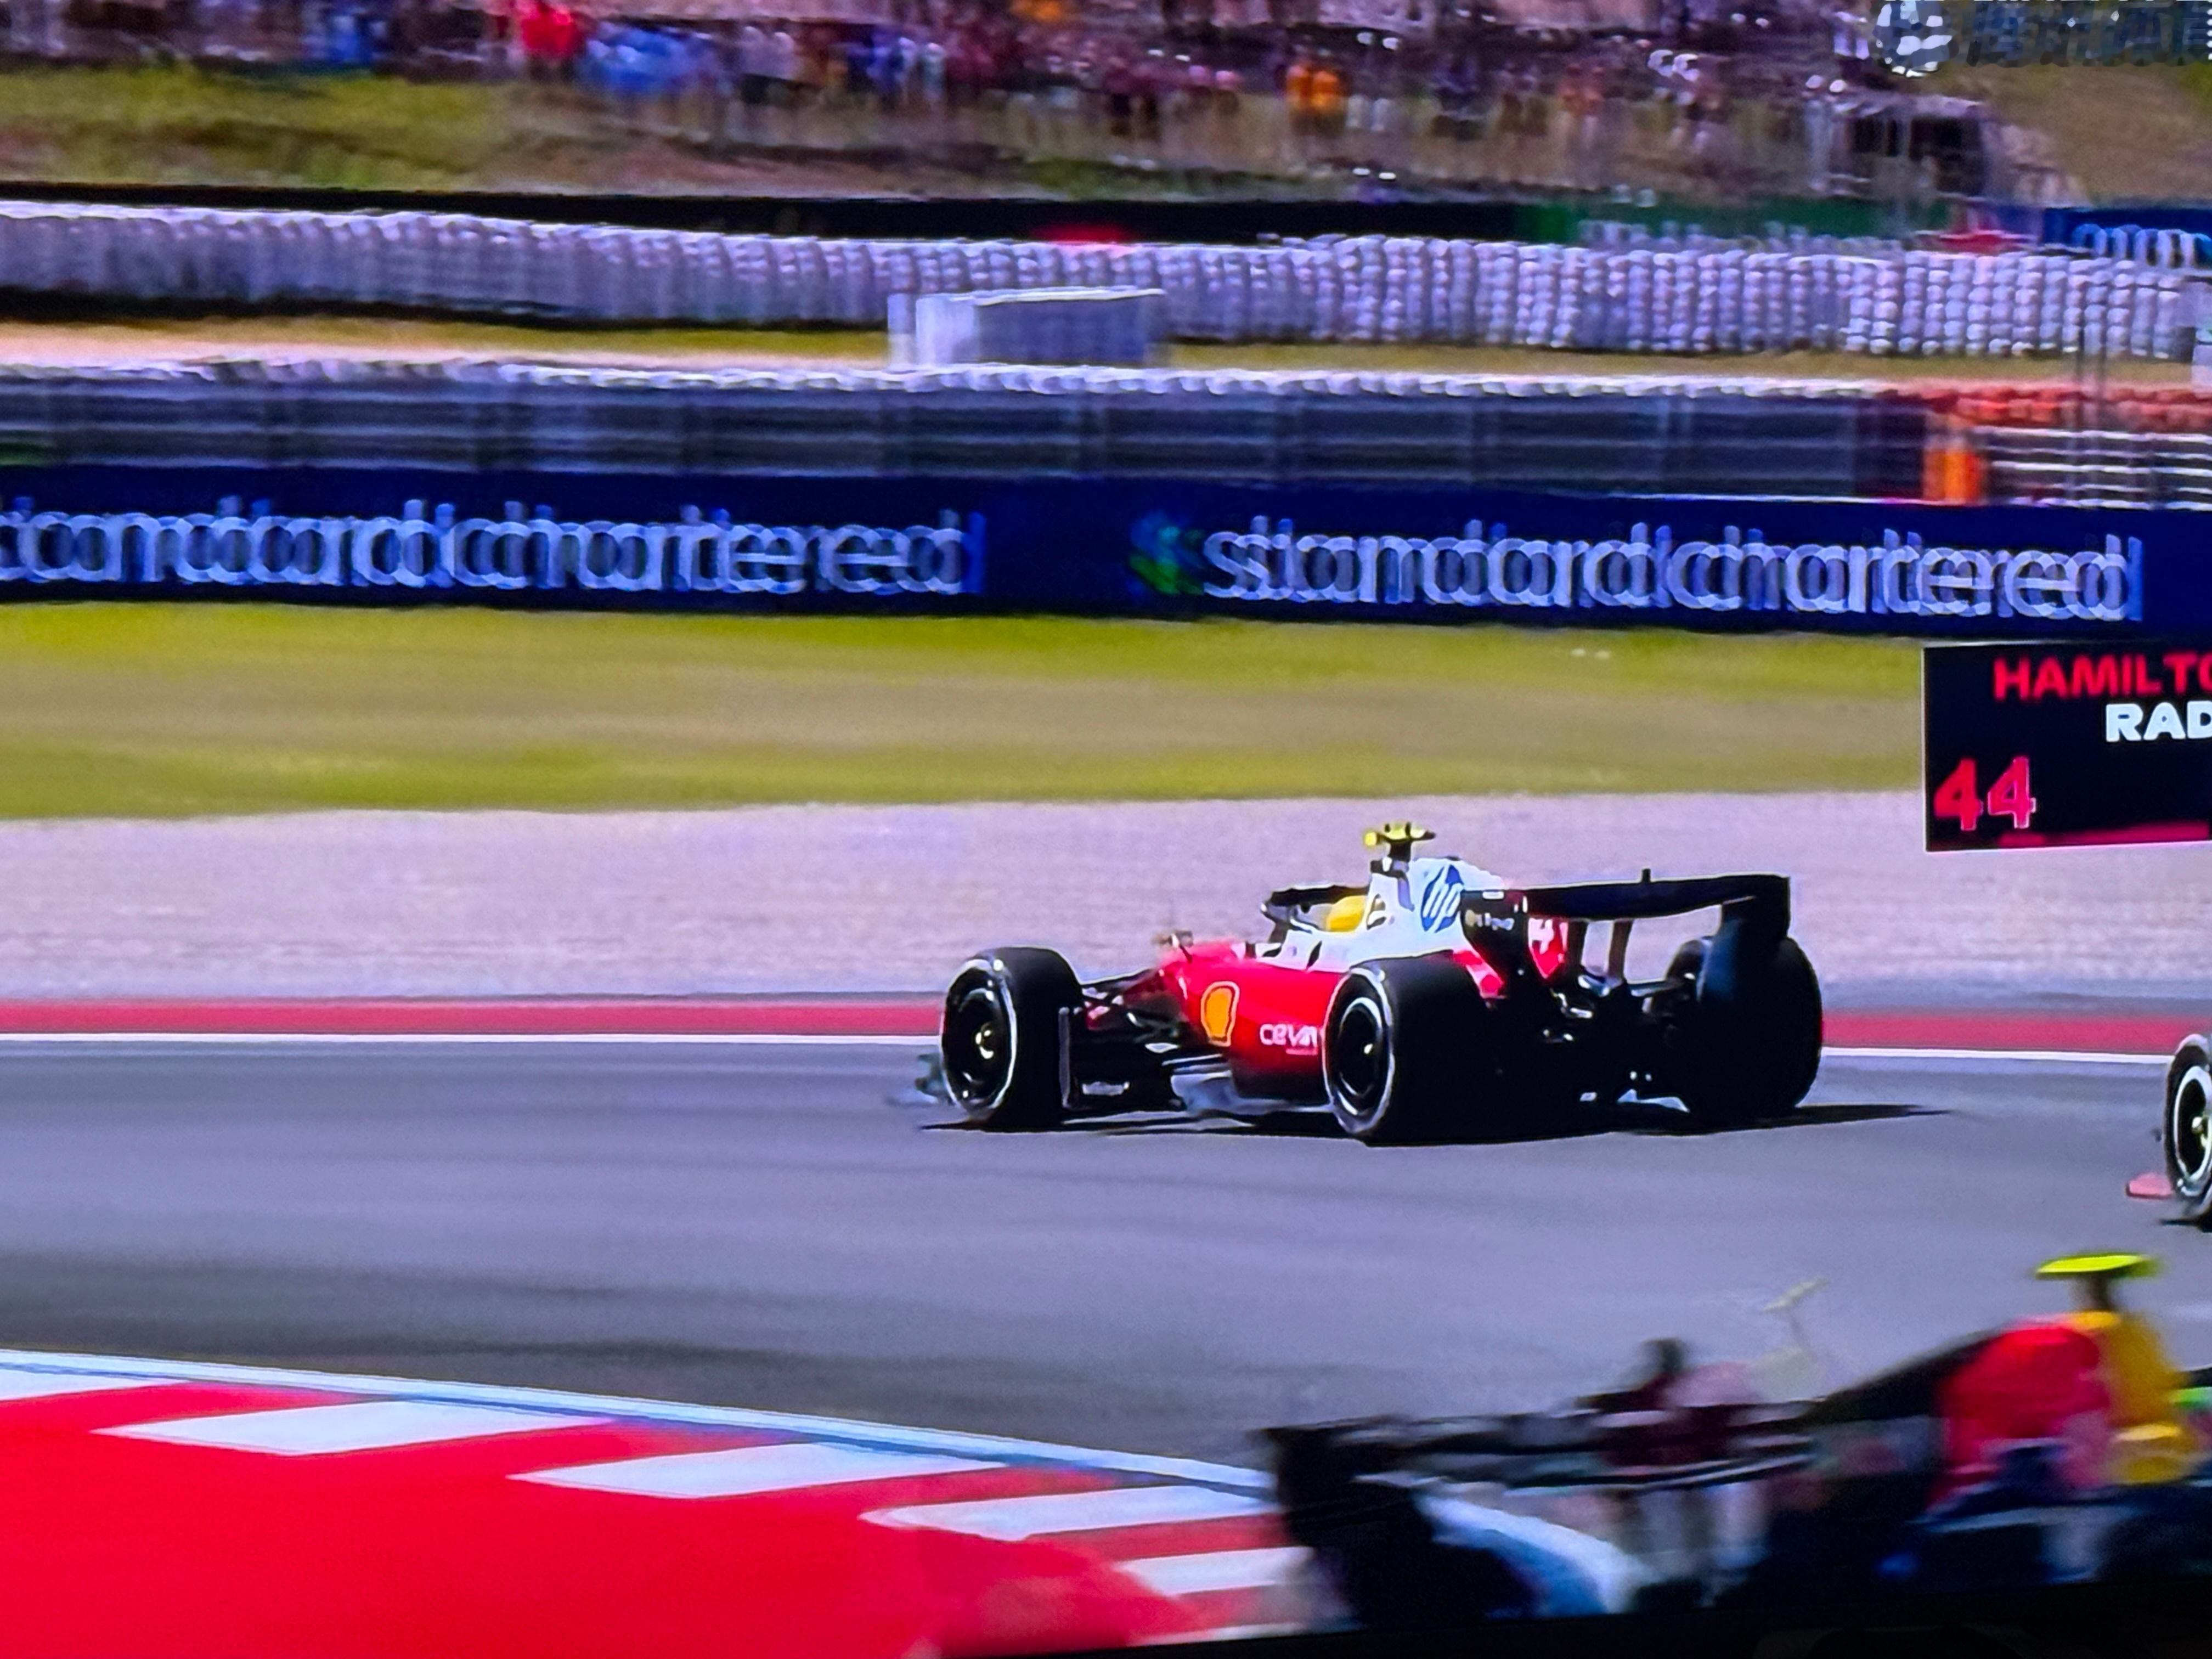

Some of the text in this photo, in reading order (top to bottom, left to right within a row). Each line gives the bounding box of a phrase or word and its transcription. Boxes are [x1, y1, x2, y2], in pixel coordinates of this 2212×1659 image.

[441, 500, 985, 595] chartered
[1204, 515, 2143, 621] standard chartered
[1934, 756, 2036, 831] 44
